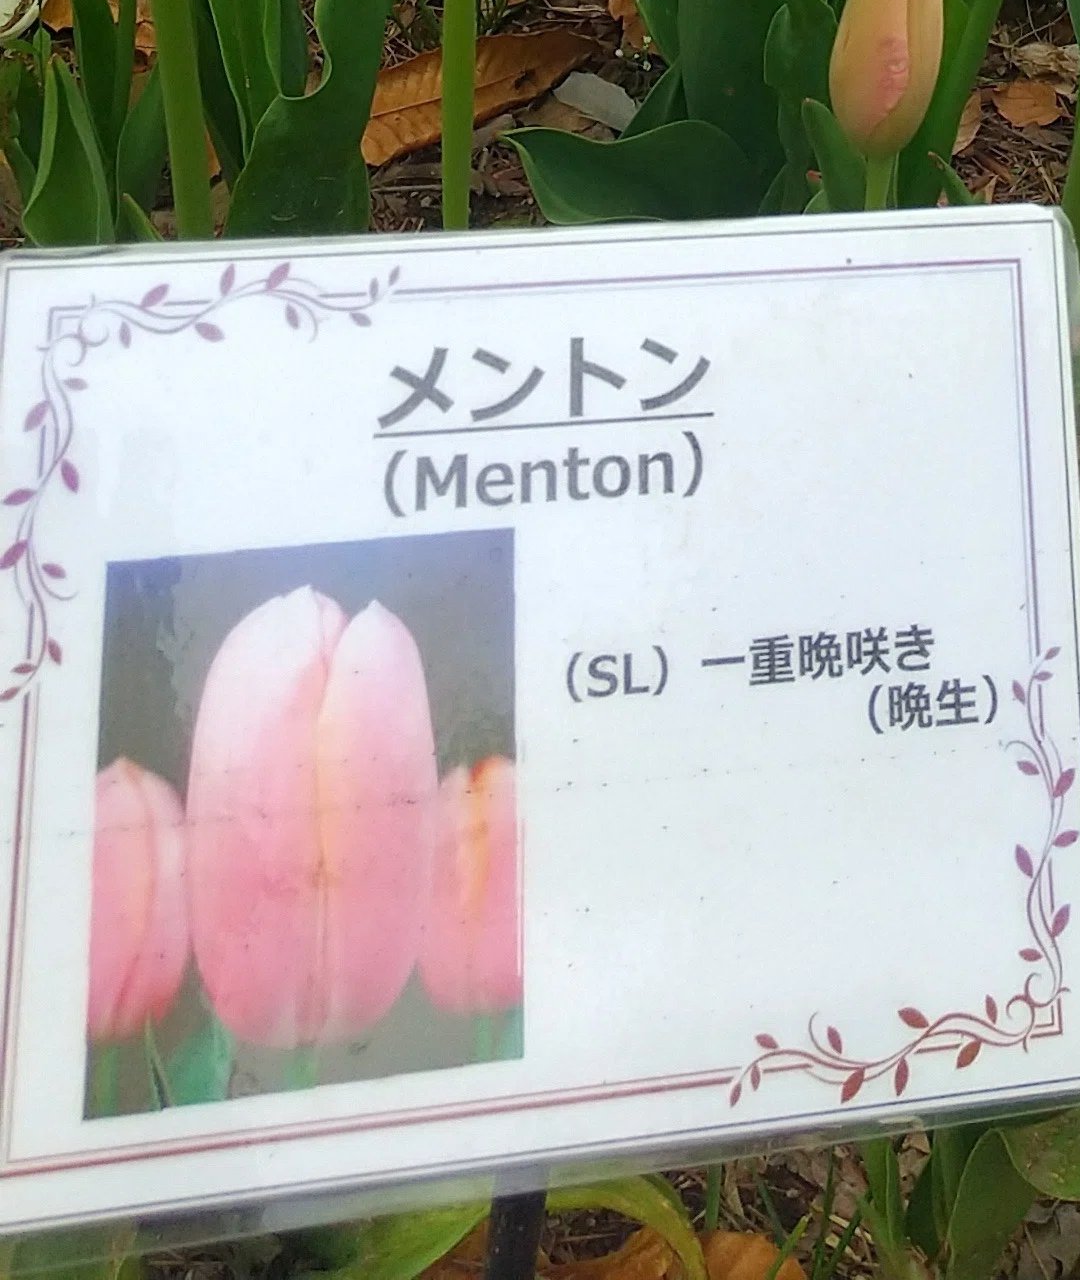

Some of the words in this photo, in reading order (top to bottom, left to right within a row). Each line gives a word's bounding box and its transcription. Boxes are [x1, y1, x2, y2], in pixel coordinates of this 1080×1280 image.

[377, 337, 711, 430] メントン
[383, 430, 704, 518] (Menton)
[701, 624, 935, 686] 一重晩咲き
